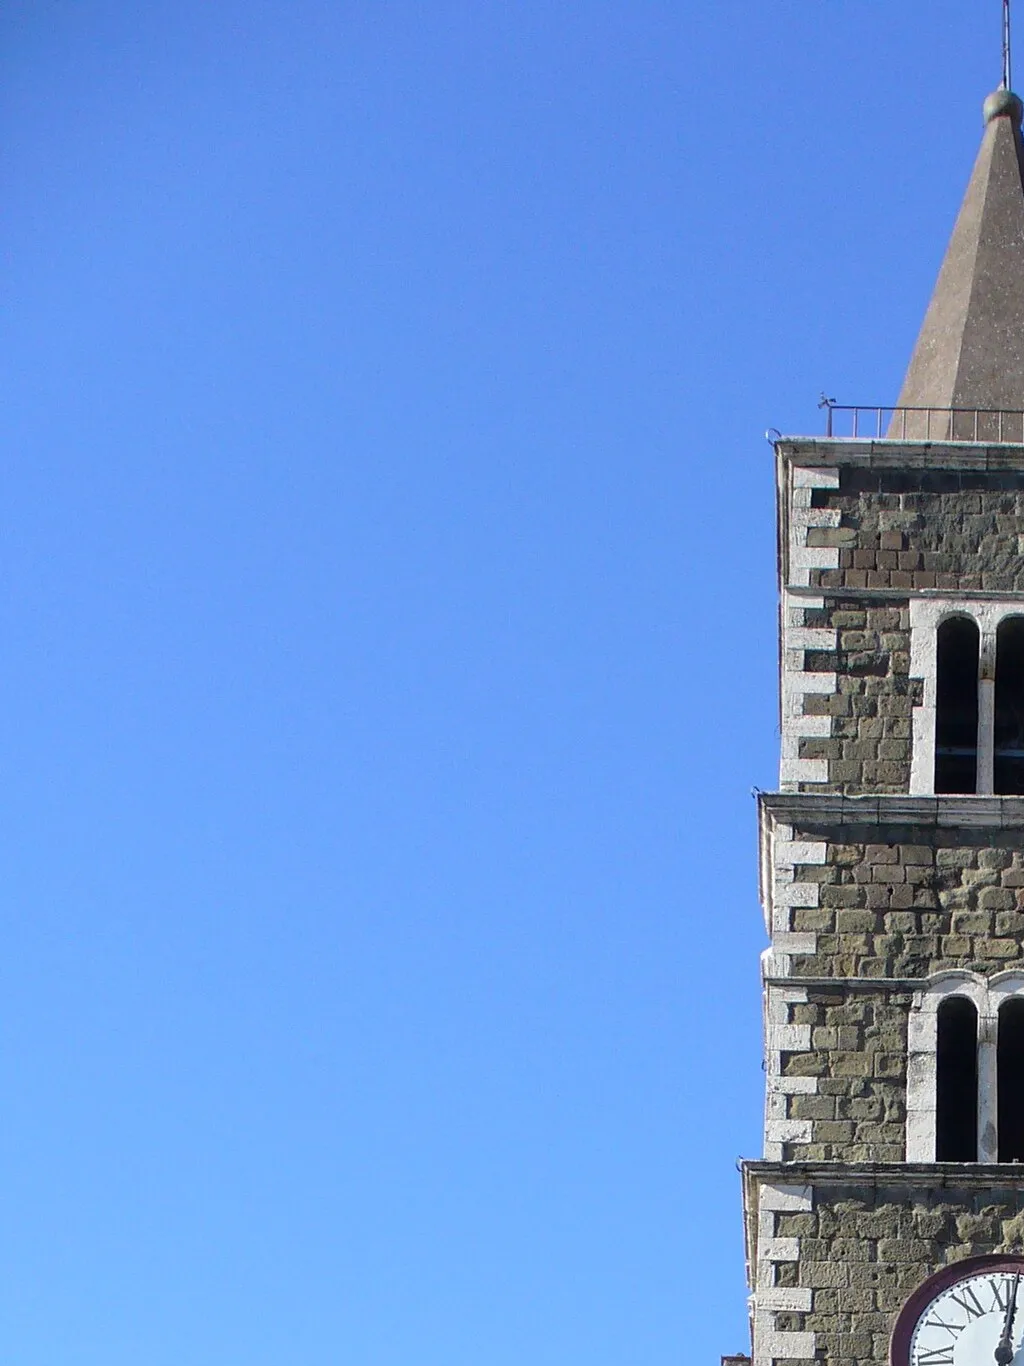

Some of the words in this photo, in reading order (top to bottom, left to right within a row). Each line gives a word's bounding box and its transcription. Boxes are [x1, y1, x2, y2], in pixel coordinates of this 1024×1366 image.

[949, 1286, 987, 1323] XI
[925, 1311, 965, 1340] X
[918, 1345, 954, 1366] IX
